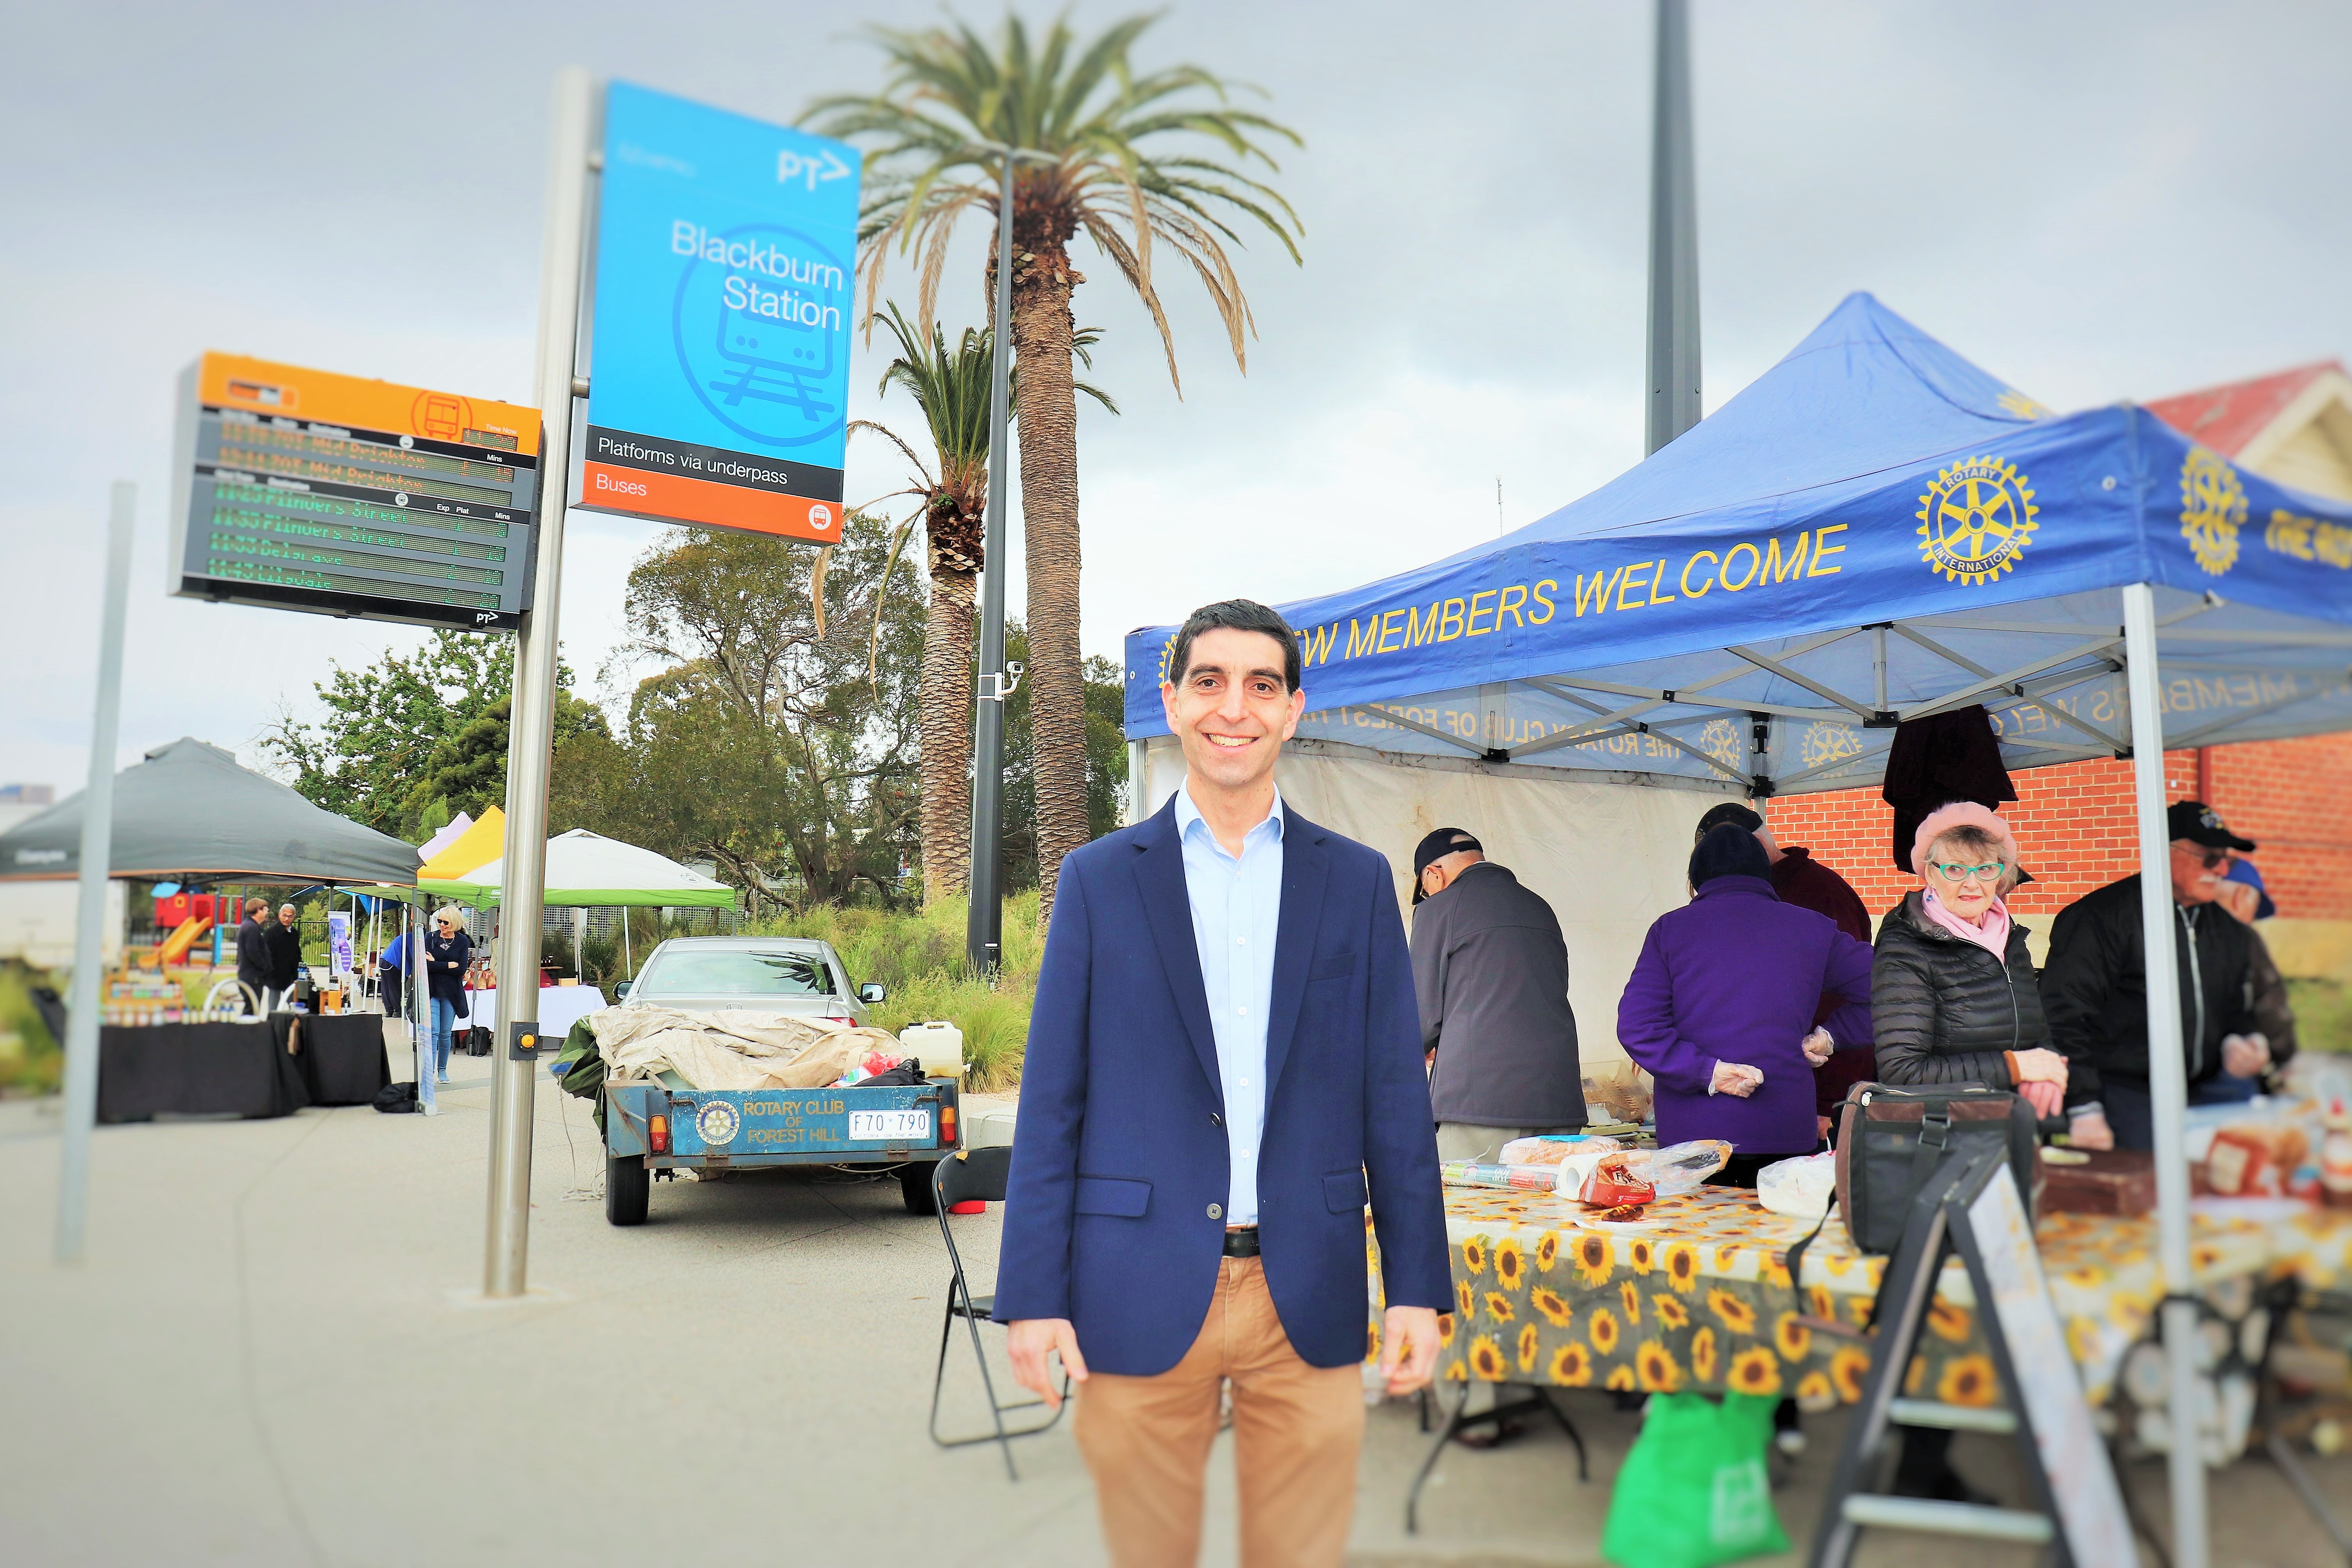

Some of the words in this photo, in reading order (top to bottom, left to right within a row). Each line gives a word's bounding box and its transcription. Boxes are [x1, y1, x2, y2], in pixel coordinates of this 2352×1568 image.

[671, 220, 842, 291] Blackburn
[723, 276, 840, 331] Station
[486, 424, 501, 432] Time
[487, 454, 503, 462] Mins
[598, 437, 675, 465] Platforms
[680, 454, 702, 470] via
[707, 461, 788, 485] underpass
[596, 474, 647, 497] Buses
[1945, 467, 1996, 488] ROTARY
[437, 504, 450, 512] Exp
[1934, 534, 2022, 572] INTERNATIONAL
[1345, 579, 1557, 660] MEMBERS
[1575, 523, 1848, 617] WELCOME
[744, 1101, 802, 1116] ROTARY
[806, 1100, 844, 1114] CLUB
[786, 1116, 802, 1127] OF
[748, 1129, 805, 1143] FOREST
[810, 1128, 840, 1142] HILL
